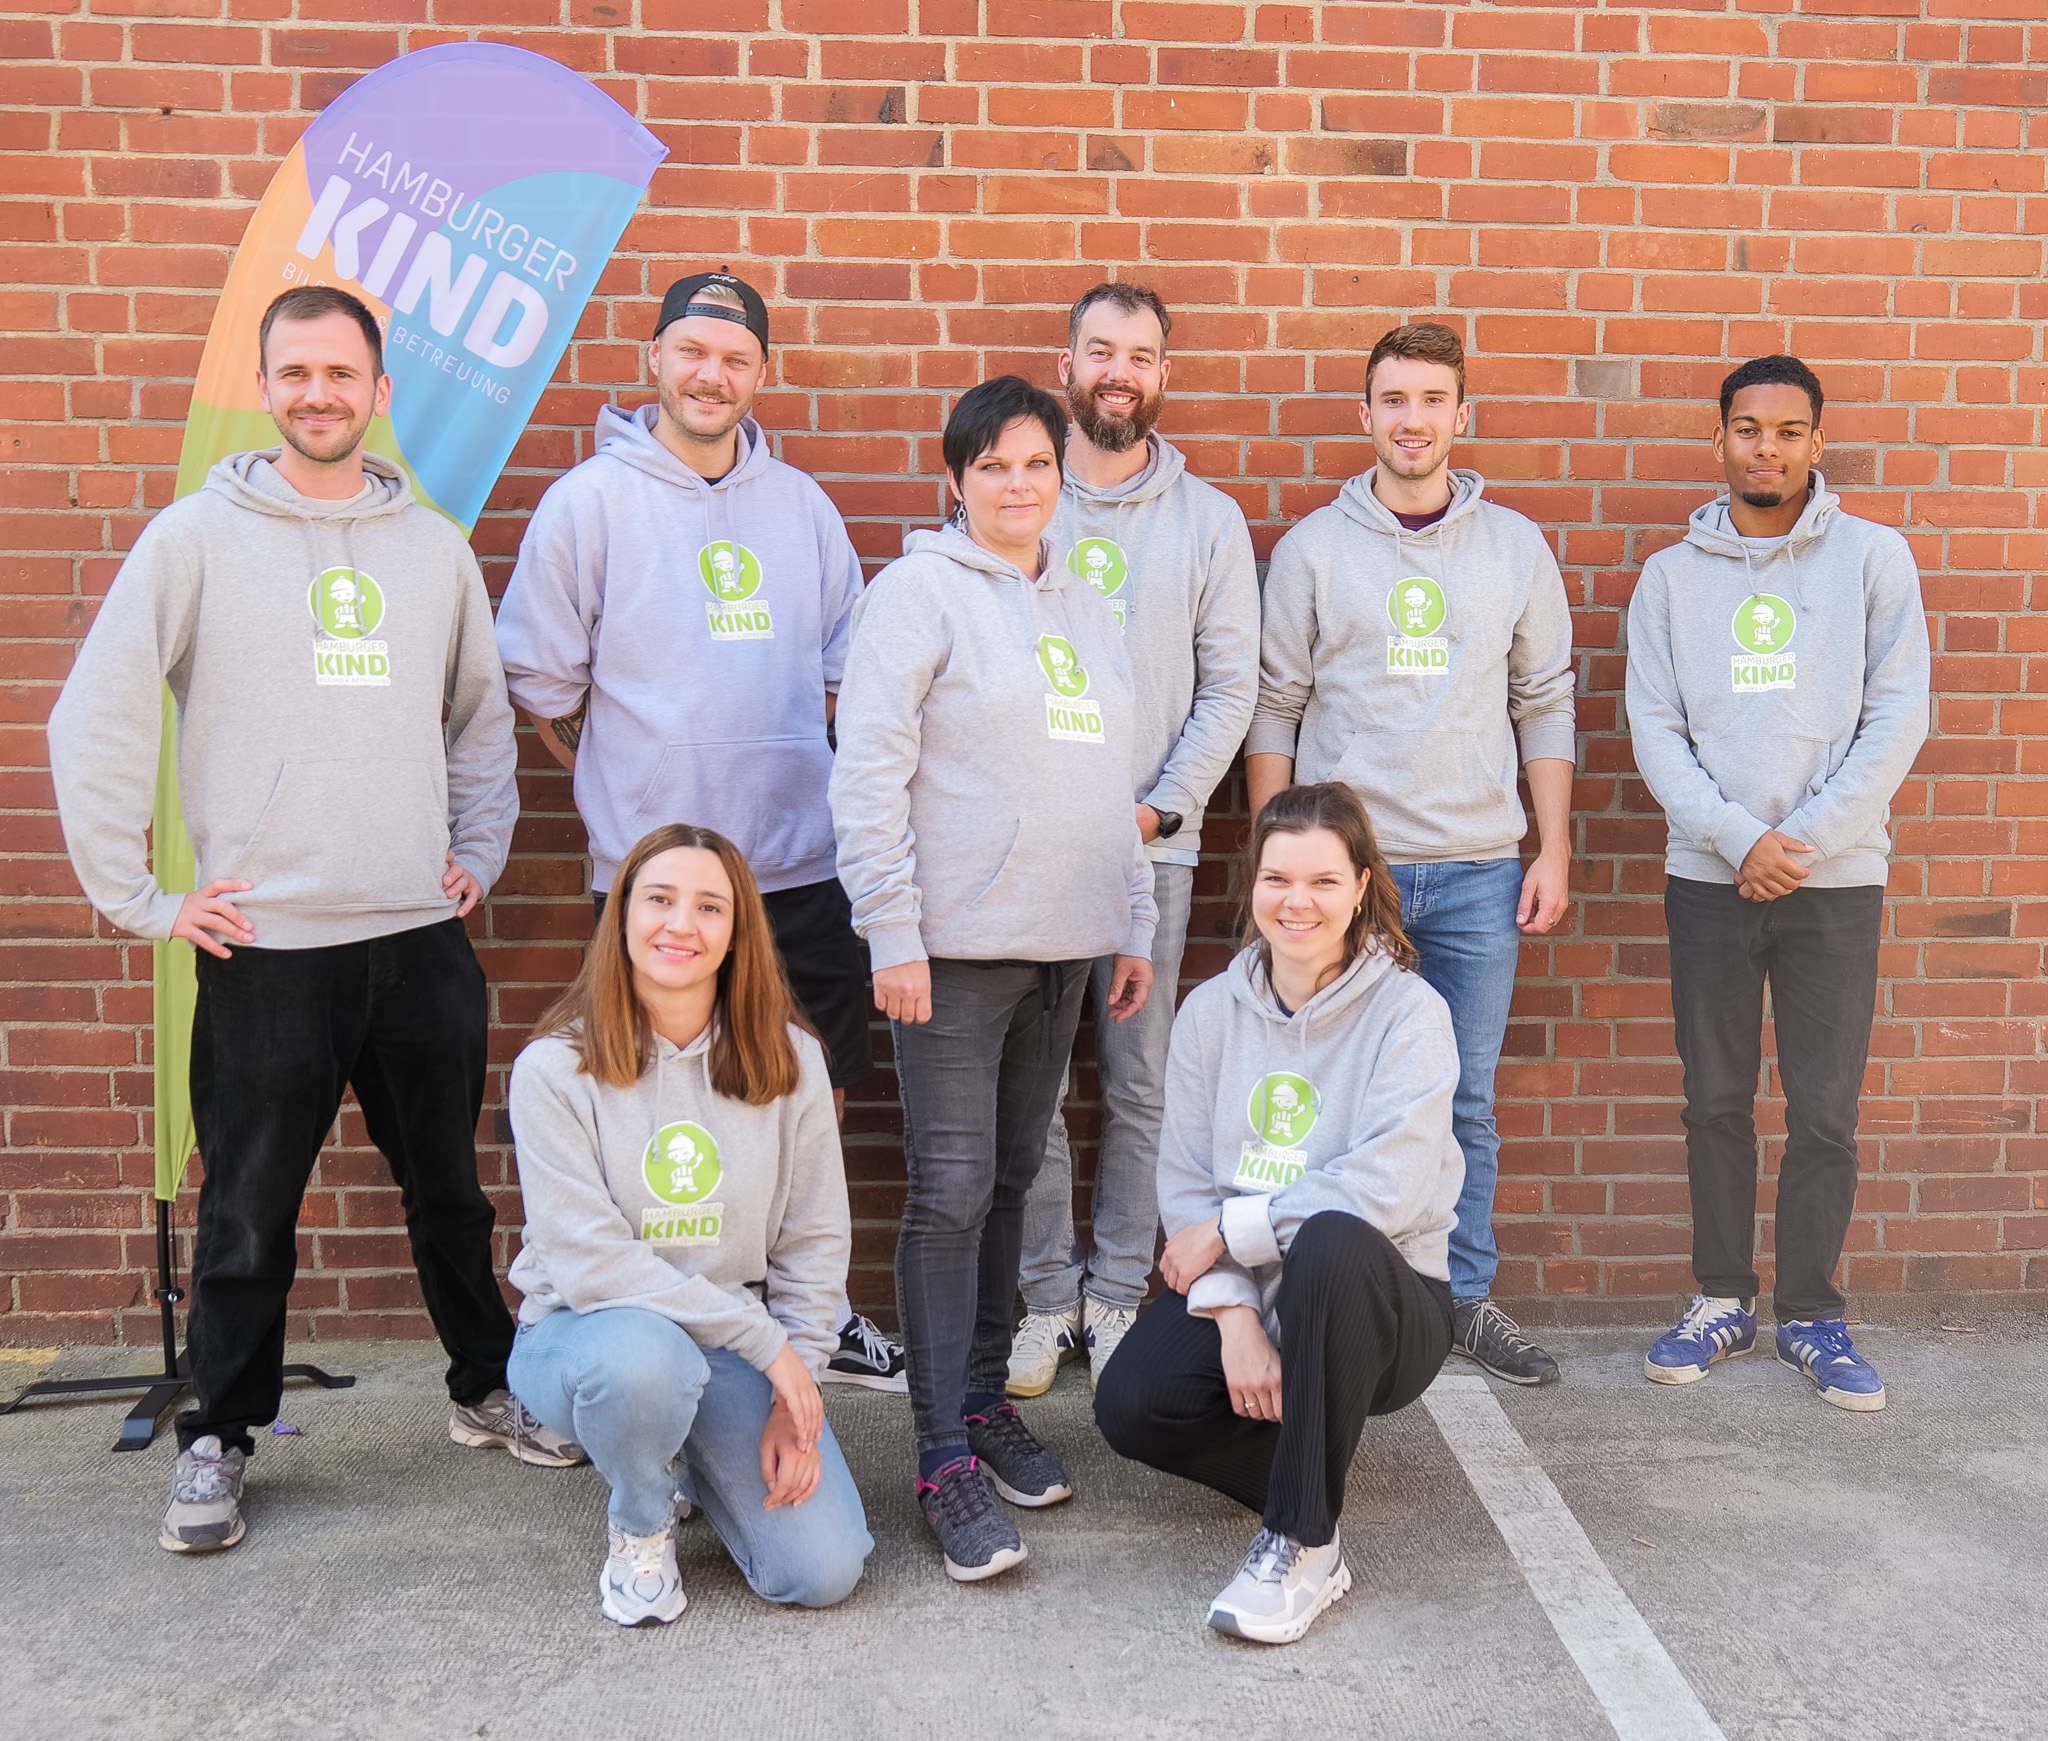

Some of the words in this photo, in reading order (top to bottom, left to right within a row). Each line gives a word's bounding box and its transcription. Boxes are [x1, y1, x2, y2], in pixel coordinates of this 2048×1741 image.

[337, 131, 579, 292] HAMBURGER
[295, 174, 550, 368] KIND
[392, 326, 511, 404] BETREUUNG
[708, 612, 772, 632] KIND
[315, 640, 387, 653] HAMBURGER
[1389, 648, 1447, 667] KIND
[317, 652, 388, 676] KIND
[1733, 653, 1795, 665] HAMBURGER
[1734, 663, 1794, 684] KIND
[1049, 707, 1103, 734] KIND
[644, 1204, 722, 1219] HAMBURGER
[643, 1216, 719, 1239] KIND
